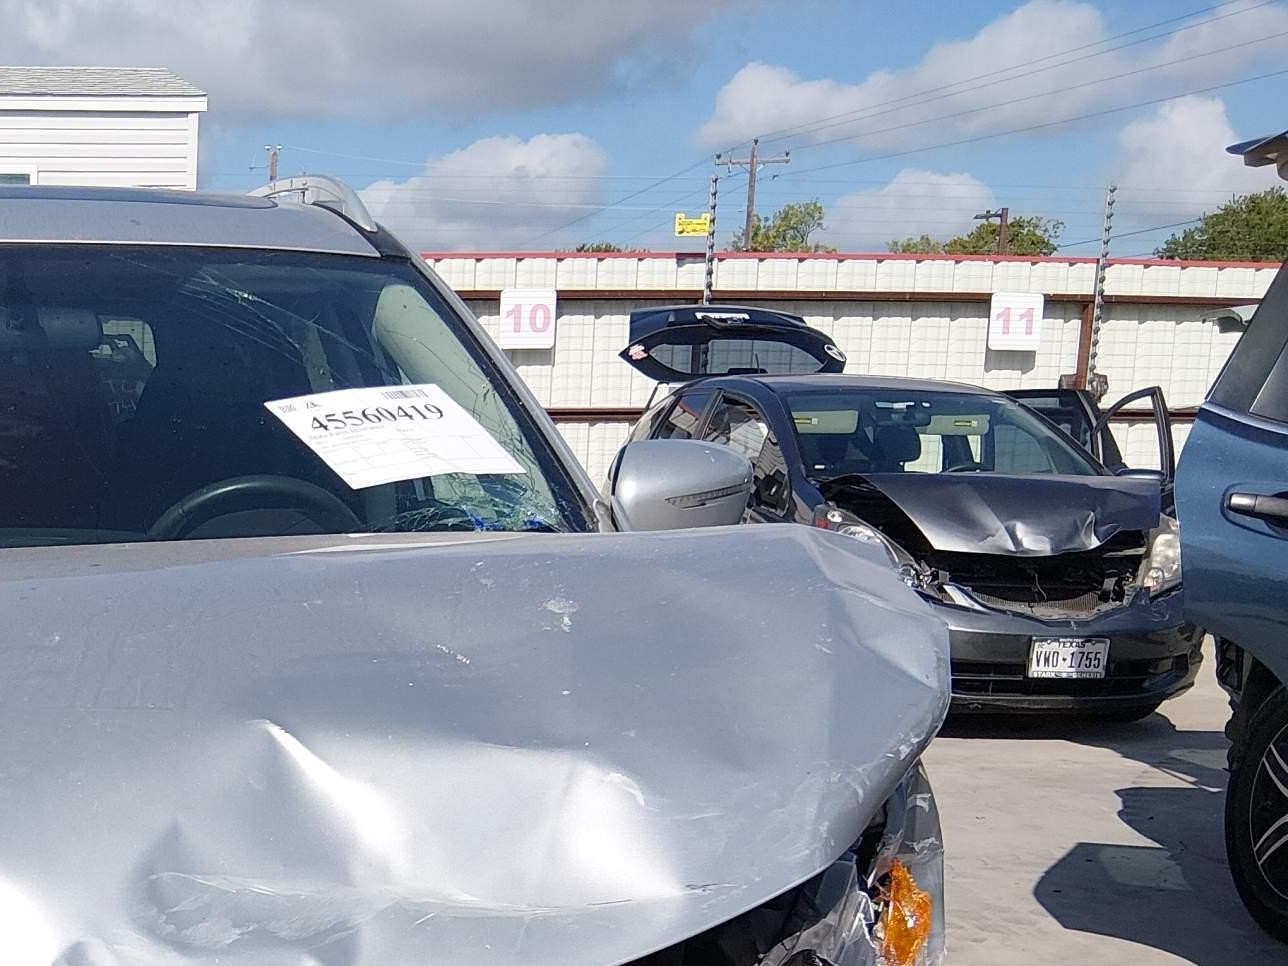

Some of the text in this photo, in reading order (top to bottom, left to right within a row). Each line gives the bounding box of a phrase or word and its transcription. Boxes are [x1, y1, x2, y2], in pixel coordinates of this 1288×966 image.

[505, 303, 552, 333] 10
[995, 306, 1035, 336] 11
[311, 403, 444, 431] 45560419
[1058, 641, 1086, 649] TEXAS
